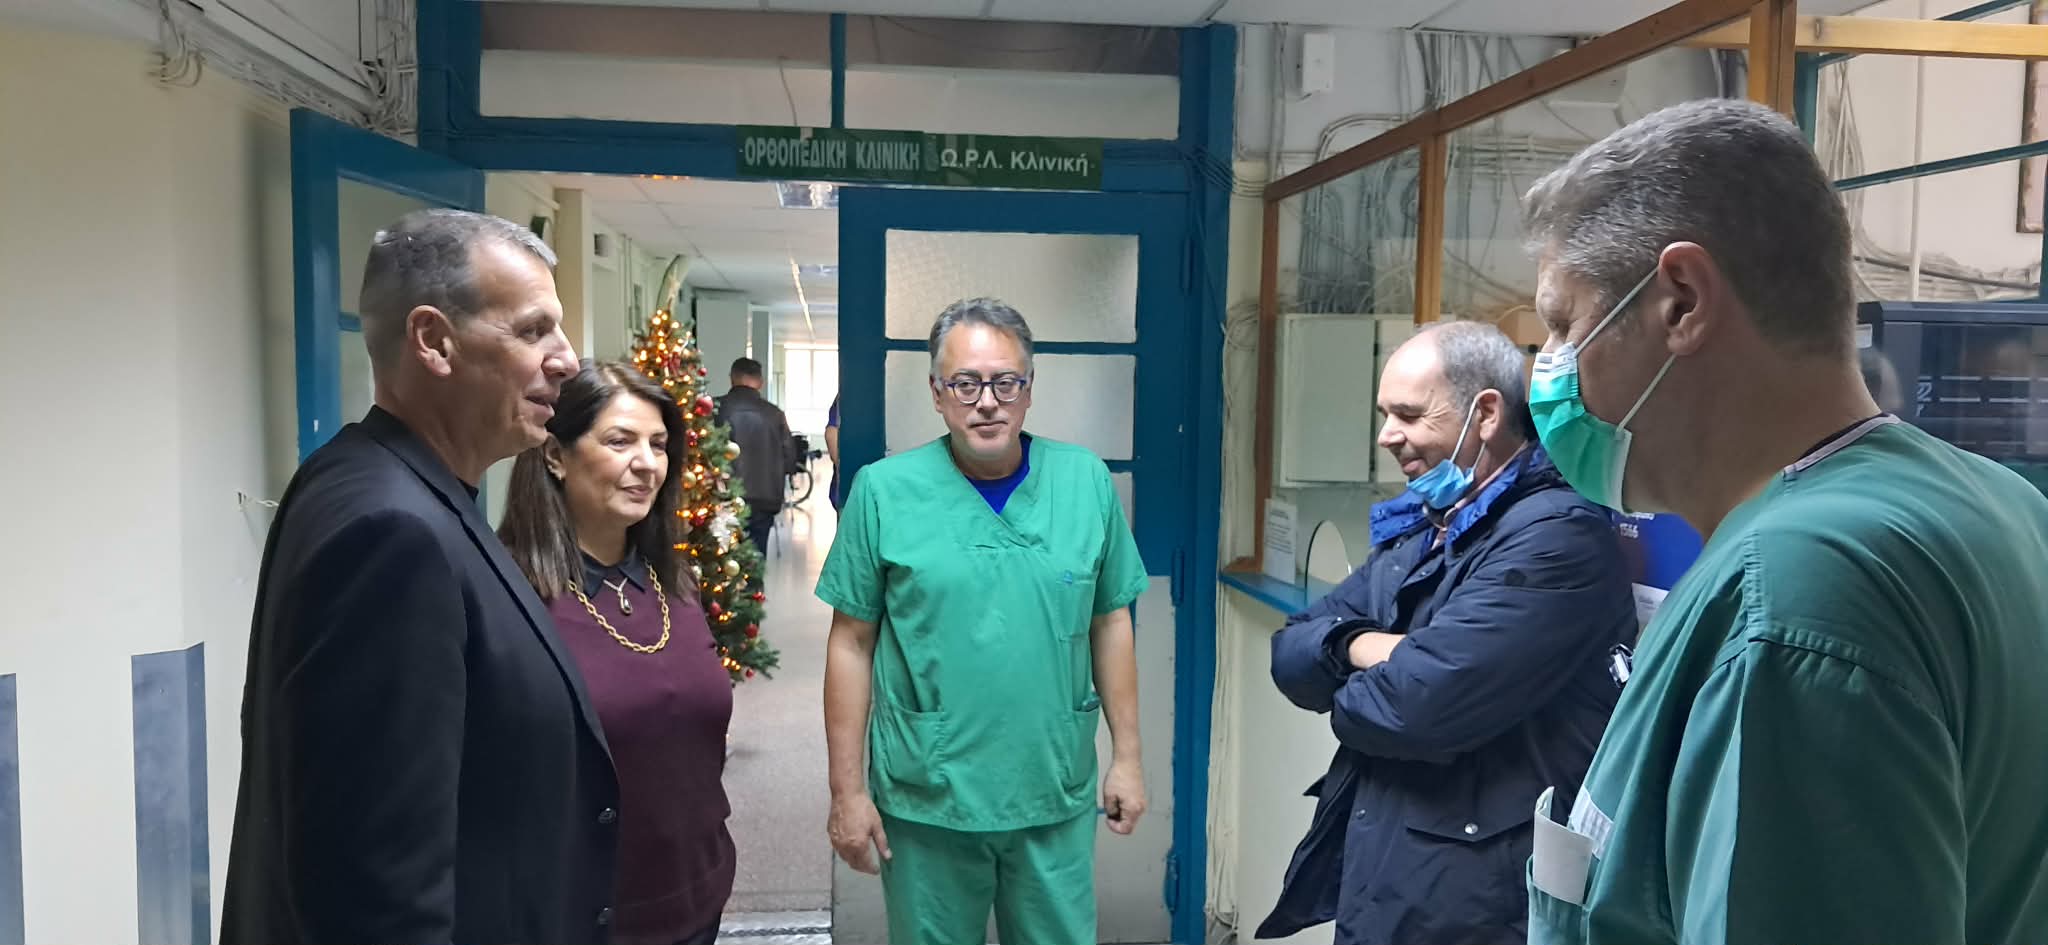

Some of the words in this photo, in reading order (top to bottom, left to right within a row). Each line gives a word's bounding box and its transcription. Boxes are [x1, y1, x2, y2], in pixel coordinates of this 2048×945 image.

[745, 136, 847, 169] ΟΡΘΟΠΕΔΙΚΗ
[856, 141, 920, 170] ΚΛΙΝΙΚΗ
[940, 148, 1003, 169] Ω.Ρ.Λ.
[1010, 151, 1088, 176] Κλινική
